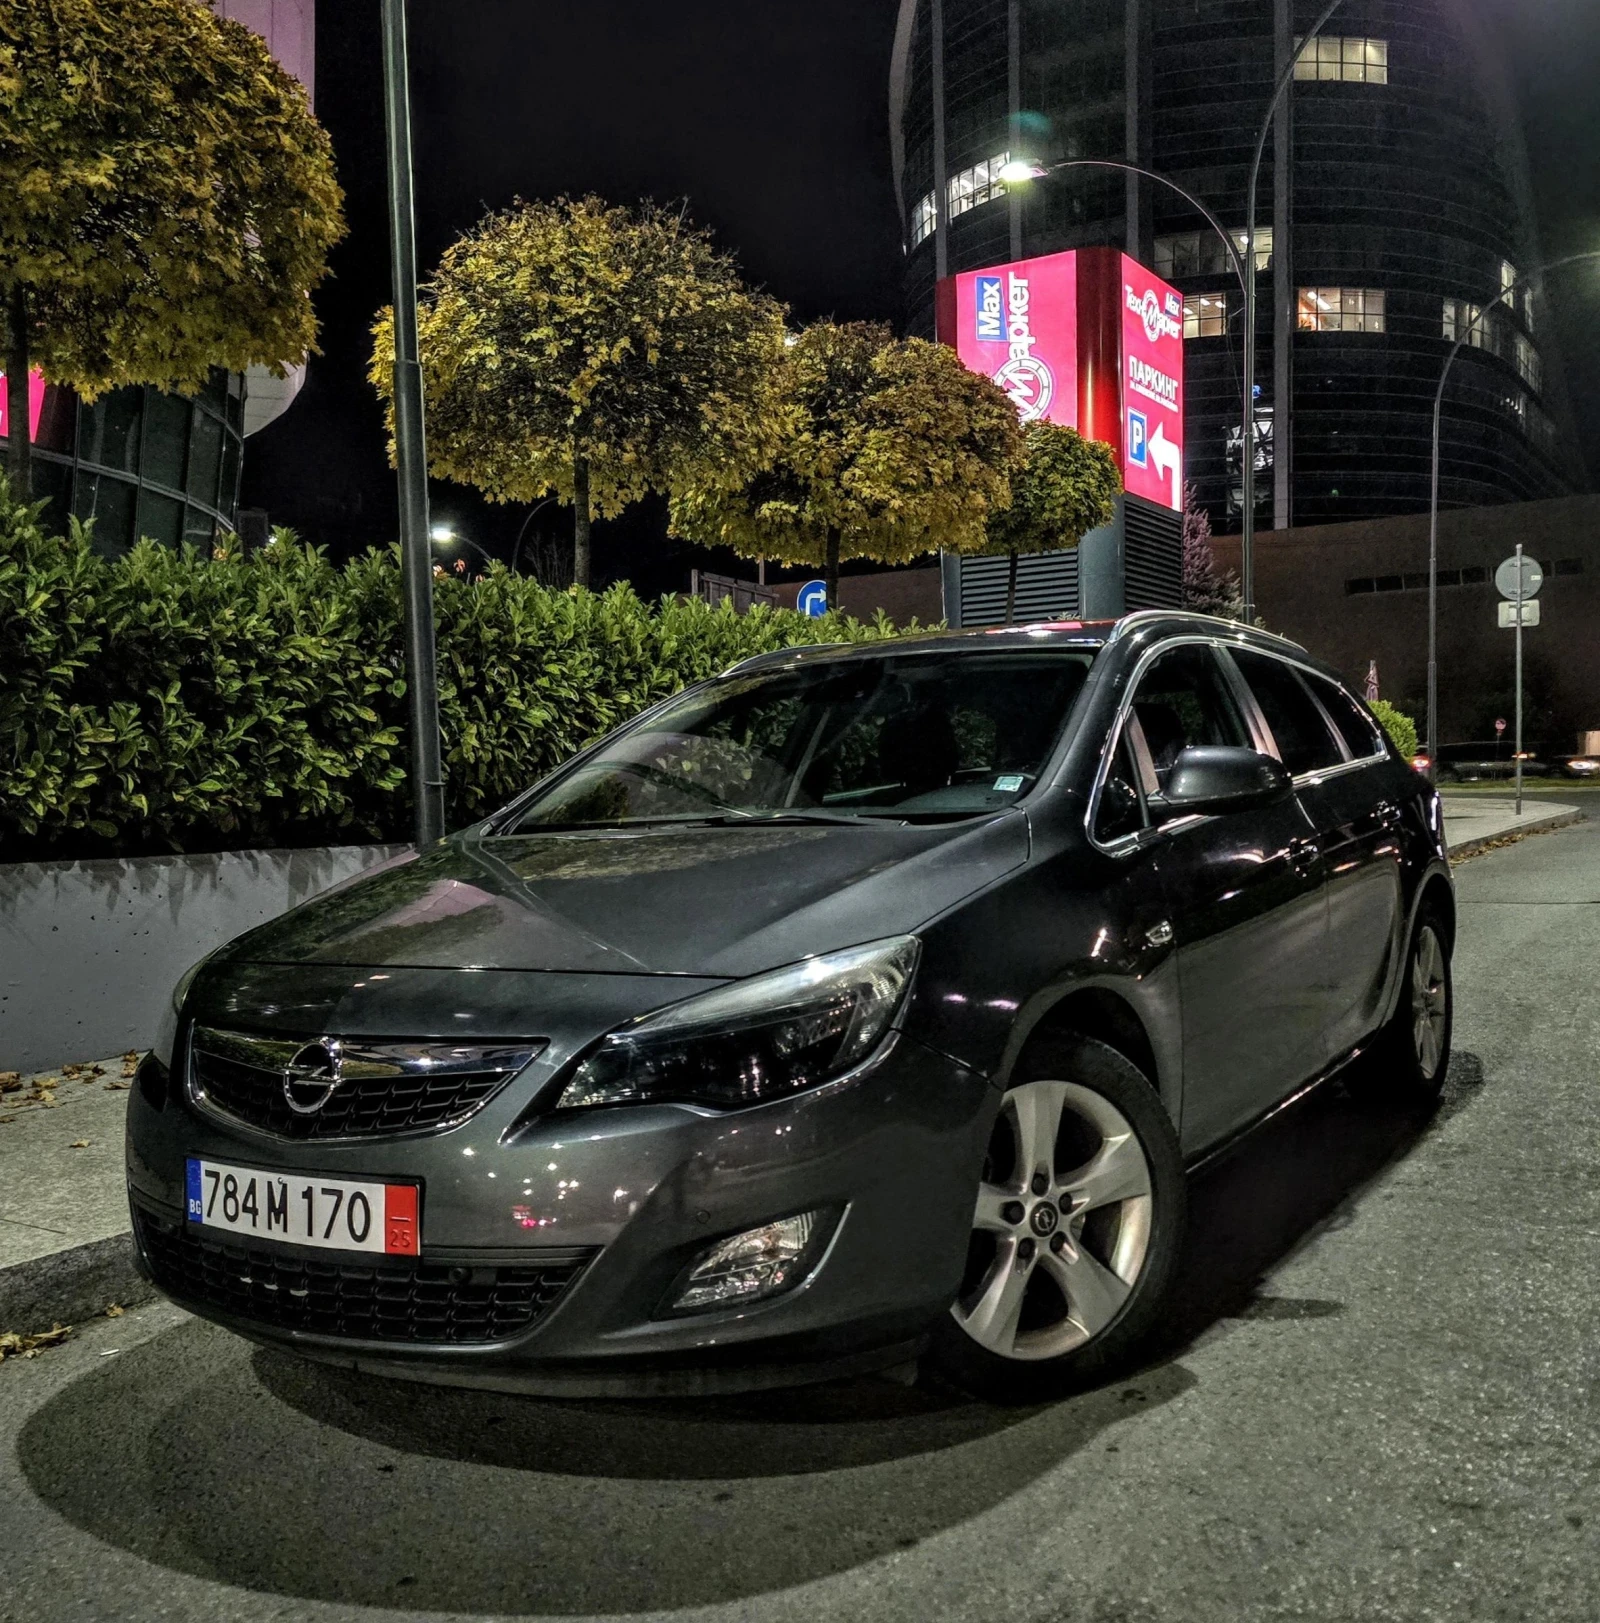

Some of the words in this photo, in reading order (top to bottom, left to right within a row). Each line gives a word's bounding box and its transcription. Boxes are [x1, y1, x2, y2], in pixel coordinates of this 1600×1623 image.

[978, 281, 1001, 336] Max
[1129, 355, 1178, 400] ПАРКИНГ
[1133, 419, 1143, 454] P
[189, 1198, 202, 1214] BG
[204, 1169, 259, 1227] 784
[267, 1181, 288, 1233] M
[301, 1186, 371, 1243] 170
[390, 1229, 411, 1248] 25
